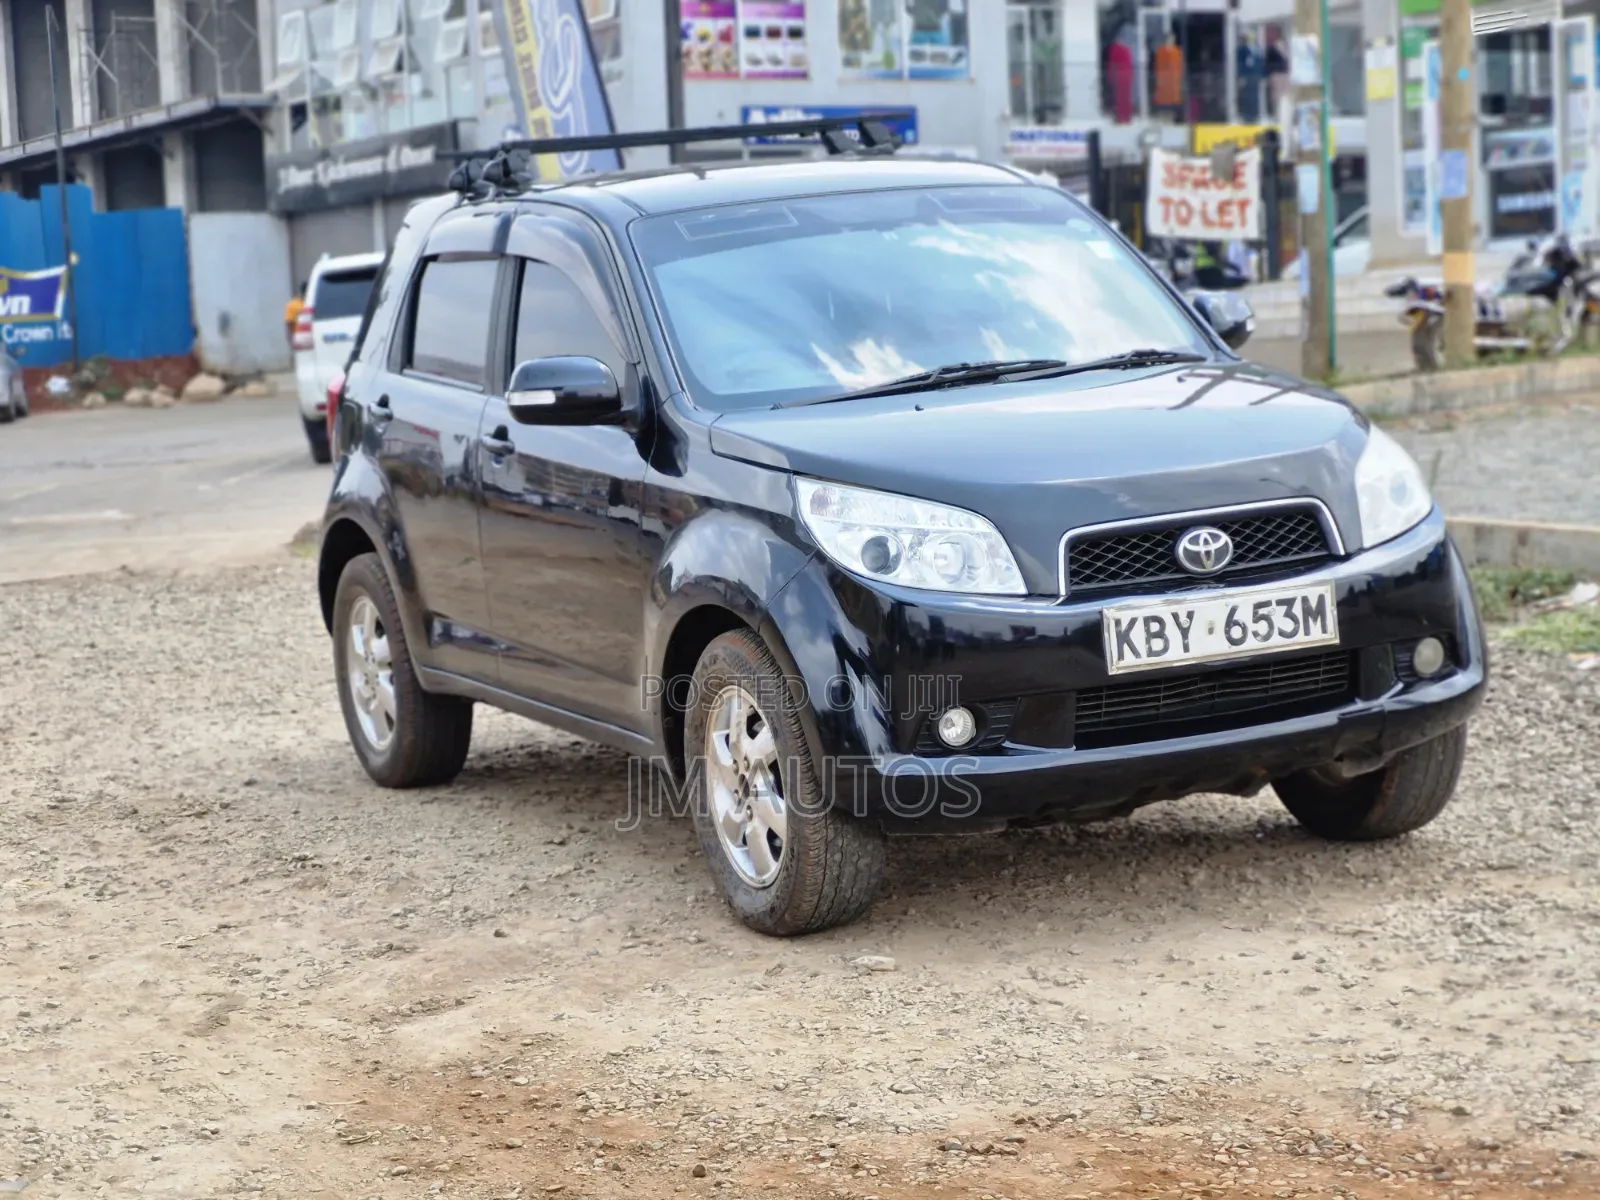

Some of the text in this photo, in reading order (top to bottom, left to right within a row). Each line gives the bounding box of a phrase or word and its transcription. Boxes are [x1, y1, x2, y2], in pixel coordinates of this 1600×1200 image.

[1157, 196, 1252, 229] TO LET
[1113, 592, 1329, 662] KBY 653M
